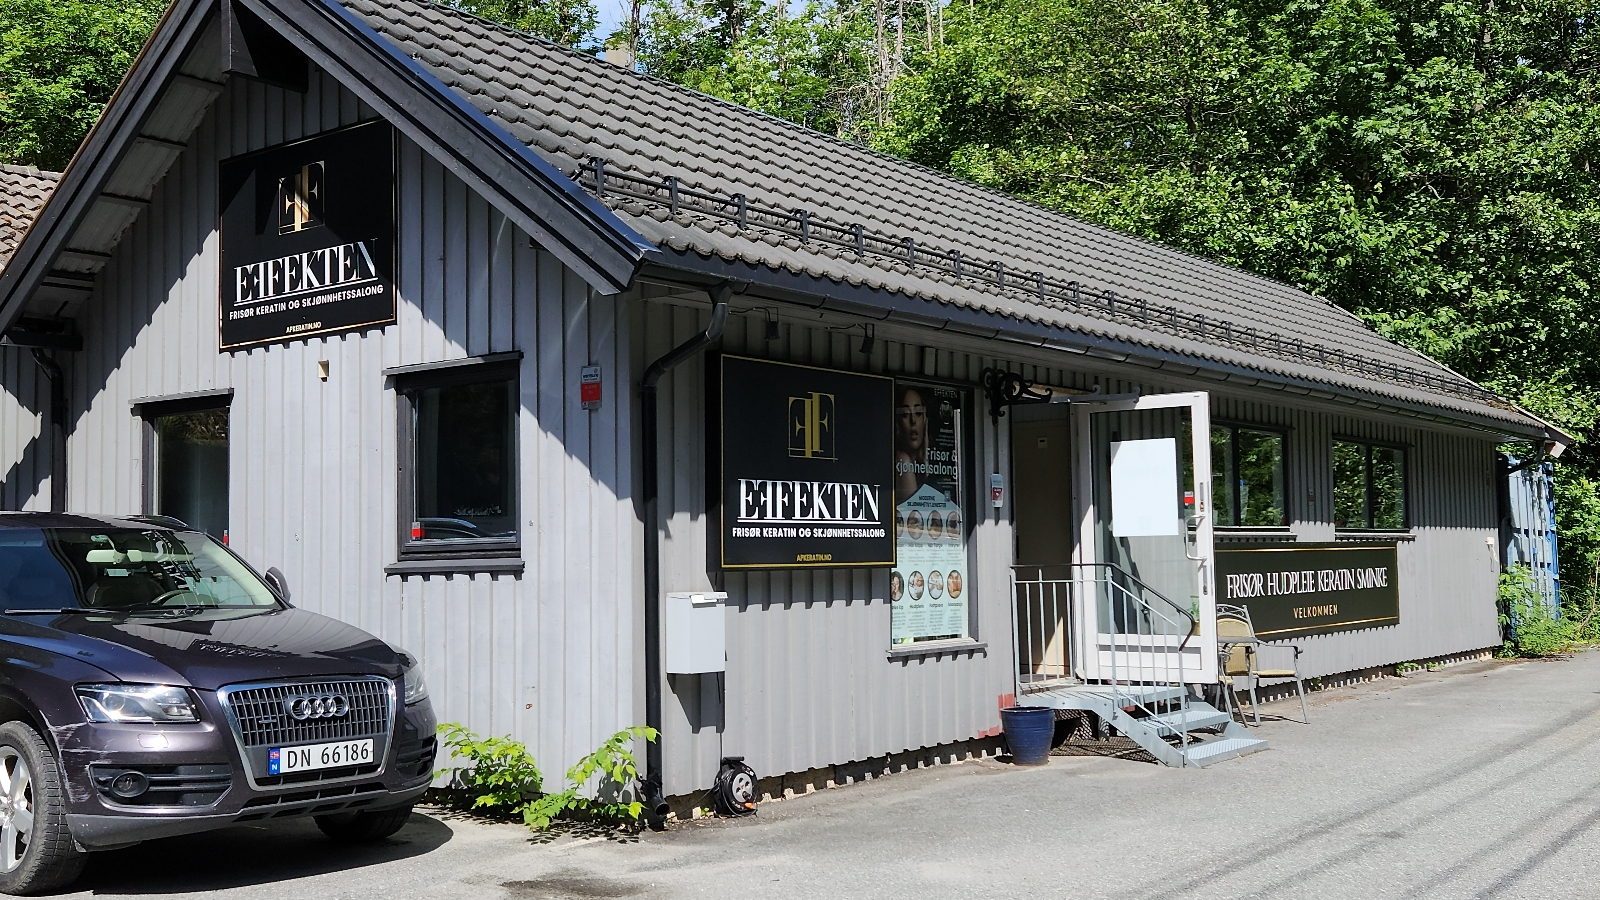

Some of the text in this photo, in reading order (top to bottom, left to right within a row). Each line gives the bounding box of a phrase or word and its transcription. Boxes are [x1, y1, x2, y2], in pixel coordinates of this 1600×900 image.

[234, 238, 378, 303] EFFEKTEN
[229, 285, 384, 320] FRISØR KERATIN OG SKJØNNHETSSALONG
[926, 447, 958, 462] Frisør &
[896, 459, 958, 479] kjønhetsalong
[738, 478, 880, 520] EFFEKTEN
[732, 527, 885, 538] FRISØR KERATIN OG SKJØNNHETSSALONG
[1226, 567, 1388, 598] FRISØR HUDPLEIE KERATIN SMINKE
[1293, 604, 1338, 619] VELKOMMEN
[287, 742, 369, 769] DN 66186
